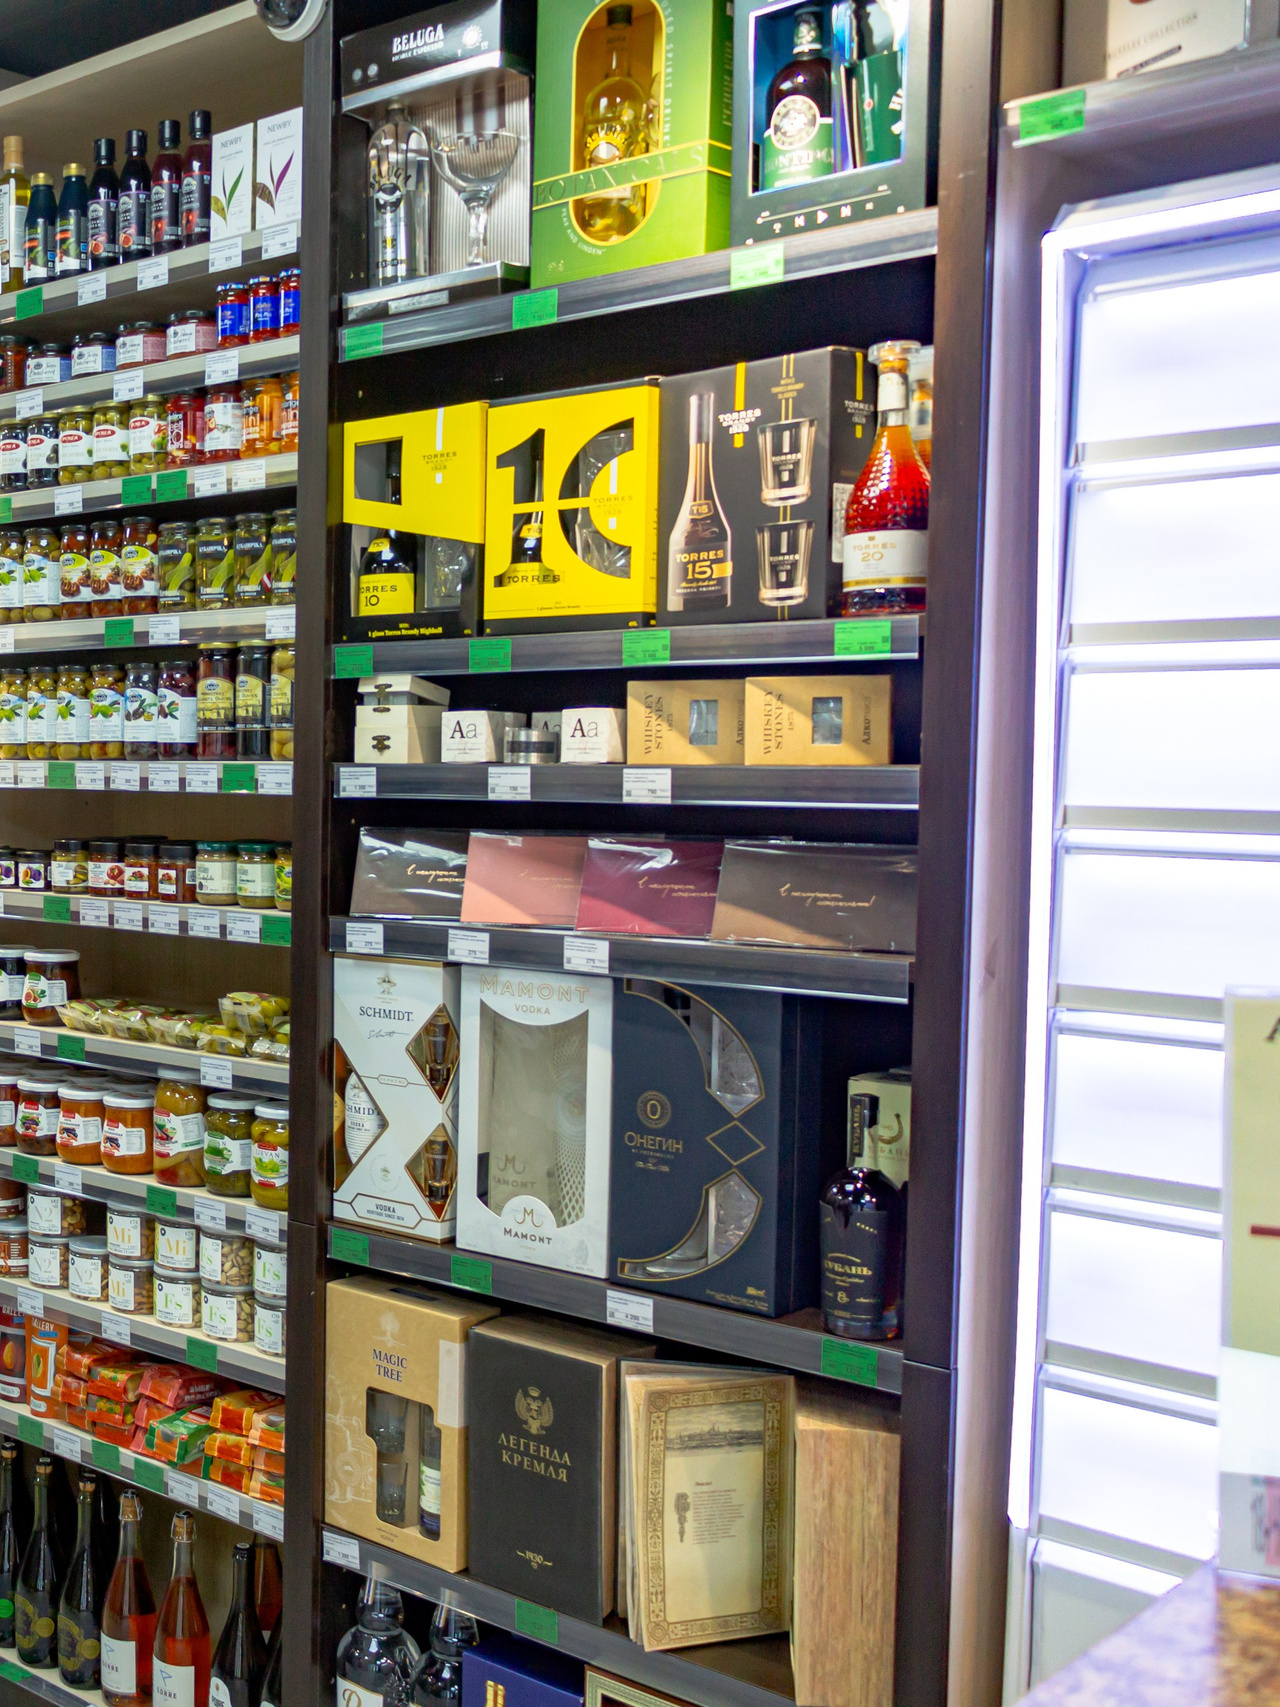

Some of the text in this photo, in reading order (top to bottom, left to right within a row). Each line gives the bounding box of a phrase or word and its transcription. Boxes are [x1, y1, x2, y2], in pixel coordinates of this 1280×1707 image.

[392, 23, 445, 54] BELUGA
[267, 120, 292, 133] NEWBY
[221, 136, 243, 148] NEWBY
[534, 145, 704, 205] BOTANICALS
[566, 228, 578, 244] AND
[718, 408, 761, 422] TORRES
[422, 451, 457, 461] TORRES
[593, 495, 633, 503] TORRES
[675, 550, 724, 563] TORRES
[852, 543, 896, 552] TORRES
[861, 551, 884, 562] 20
[507, 574, 561, 584] TORRES
[686, 561, 712, 580] 15
[365, 595, 379, 607] 10
[450, 720, 477, 740] Aa
[571, 718, 599, 738] Aa
[645, 694, 653, 755] WHISKEY
[655, 696, 663, 750] STONES
[763, 690, 773, 755] WHISKEY
[775, 693, 784, 750] STONES
[480, 974, 590, 1004] MAMONT
[359, 1006, 413, 1022] SCHMIDT
[514, 1003, 551, 1015] VODKA
[624, 1131, 683, 1154] ОНЕГИН
[375, 1203, 396, 1213] VODKA
[113, 1226, 132, 1244] Mi
[503, 1227, 552, 1245] MAMONT
[166, 1238, 187, 1256] Mi
[262, 1261, 281, 1281] Fs
[110, 1278, 126, 1297] Mi
[2, 1305, 24, 1317] GALLE
[164, 1293, 183, 1311] Fs
[208, 1305, 227, 1325] Fs
[257, 1318, 273, 1337] Fs
[372, 1349, 407, 1369] MAGIC
[376, 1365, 402, 1382] TREE
[498, 1433, 572, 1466] ЛЕГЕНДА
[502, 1450, 568, 1483] КРЕМЛЯ
